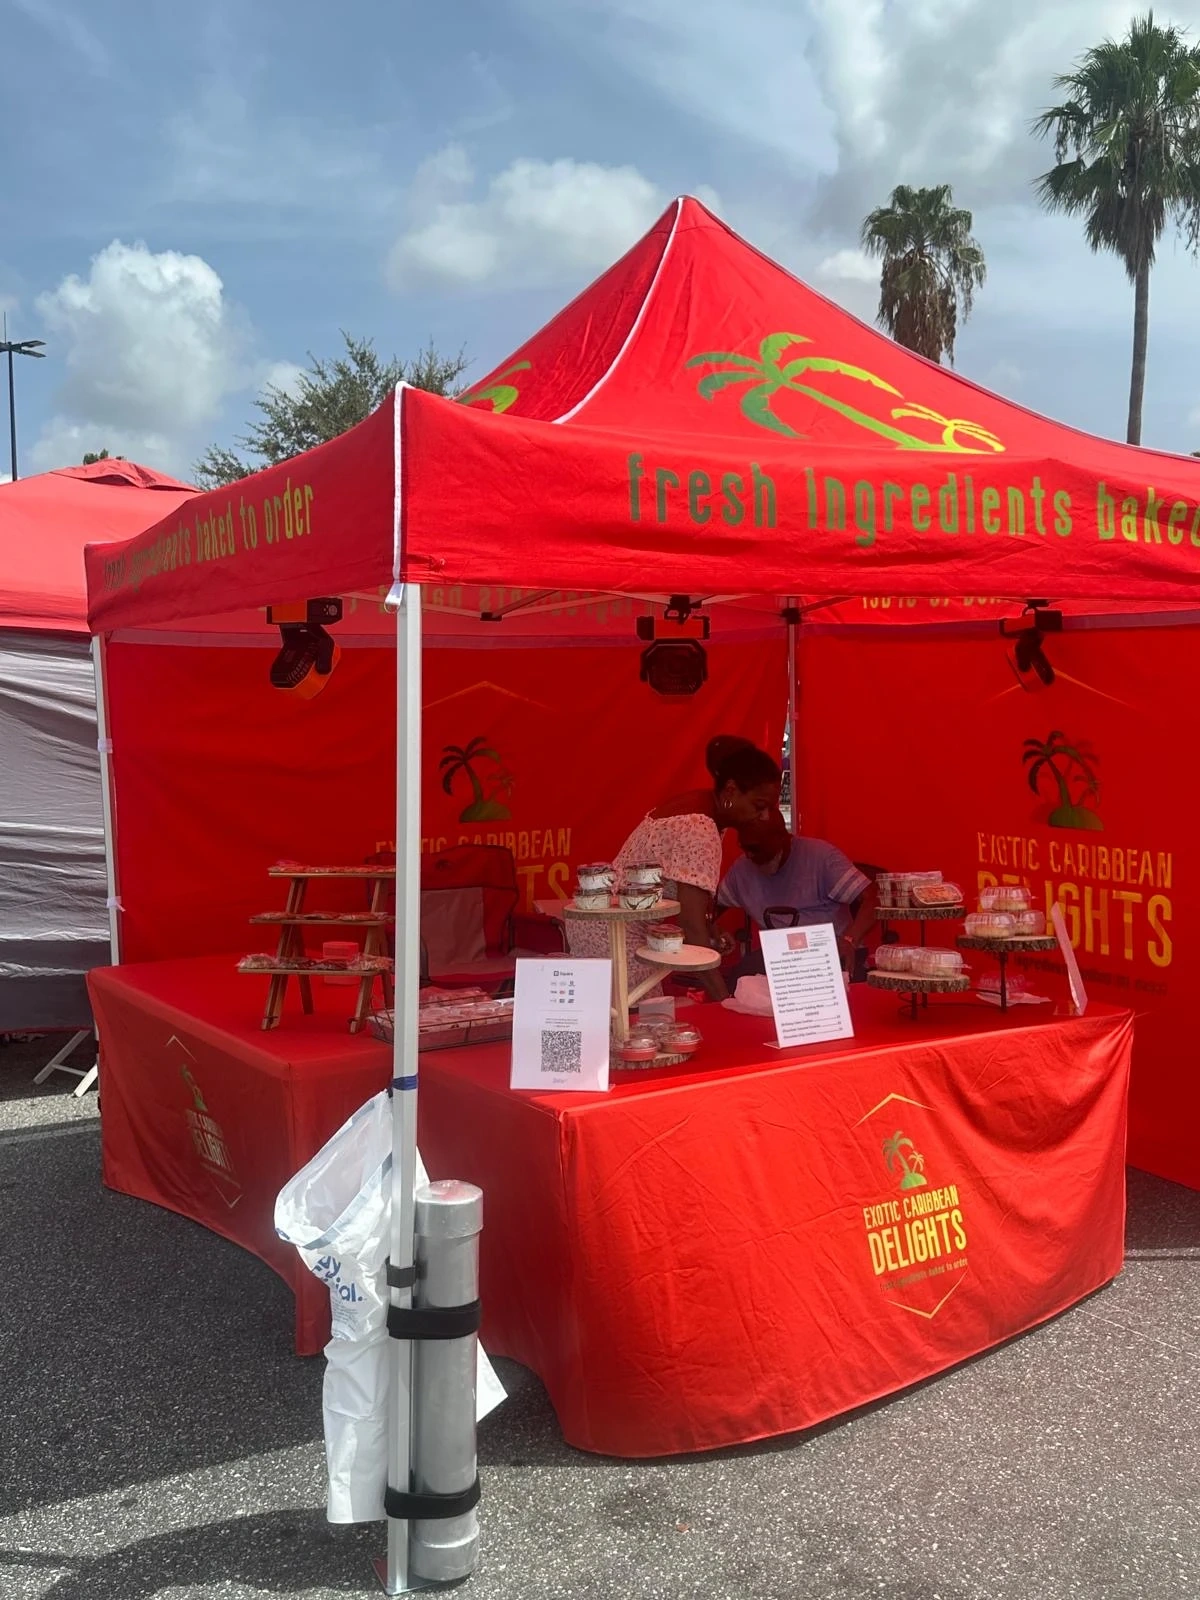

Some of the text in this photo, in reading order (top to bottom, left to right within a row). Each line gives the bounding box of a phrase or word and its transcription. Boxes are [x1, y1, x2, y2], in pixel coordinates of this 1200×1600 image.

[240, 495, 258, 550] to
[263, 477, 314, 545] order
[626, 452, 777, 529] fresh
[806, 466, 1073, 547] ingredients
[977, 832, 1172, 889] EXOTIC CARIBBEAN
[977, 871, 1173, 968] IGHTS
[863, 1184, 959, 1230] EXOTIC CARIBBEAN
[868, 1209, 967, 1276] DELIGHTS
